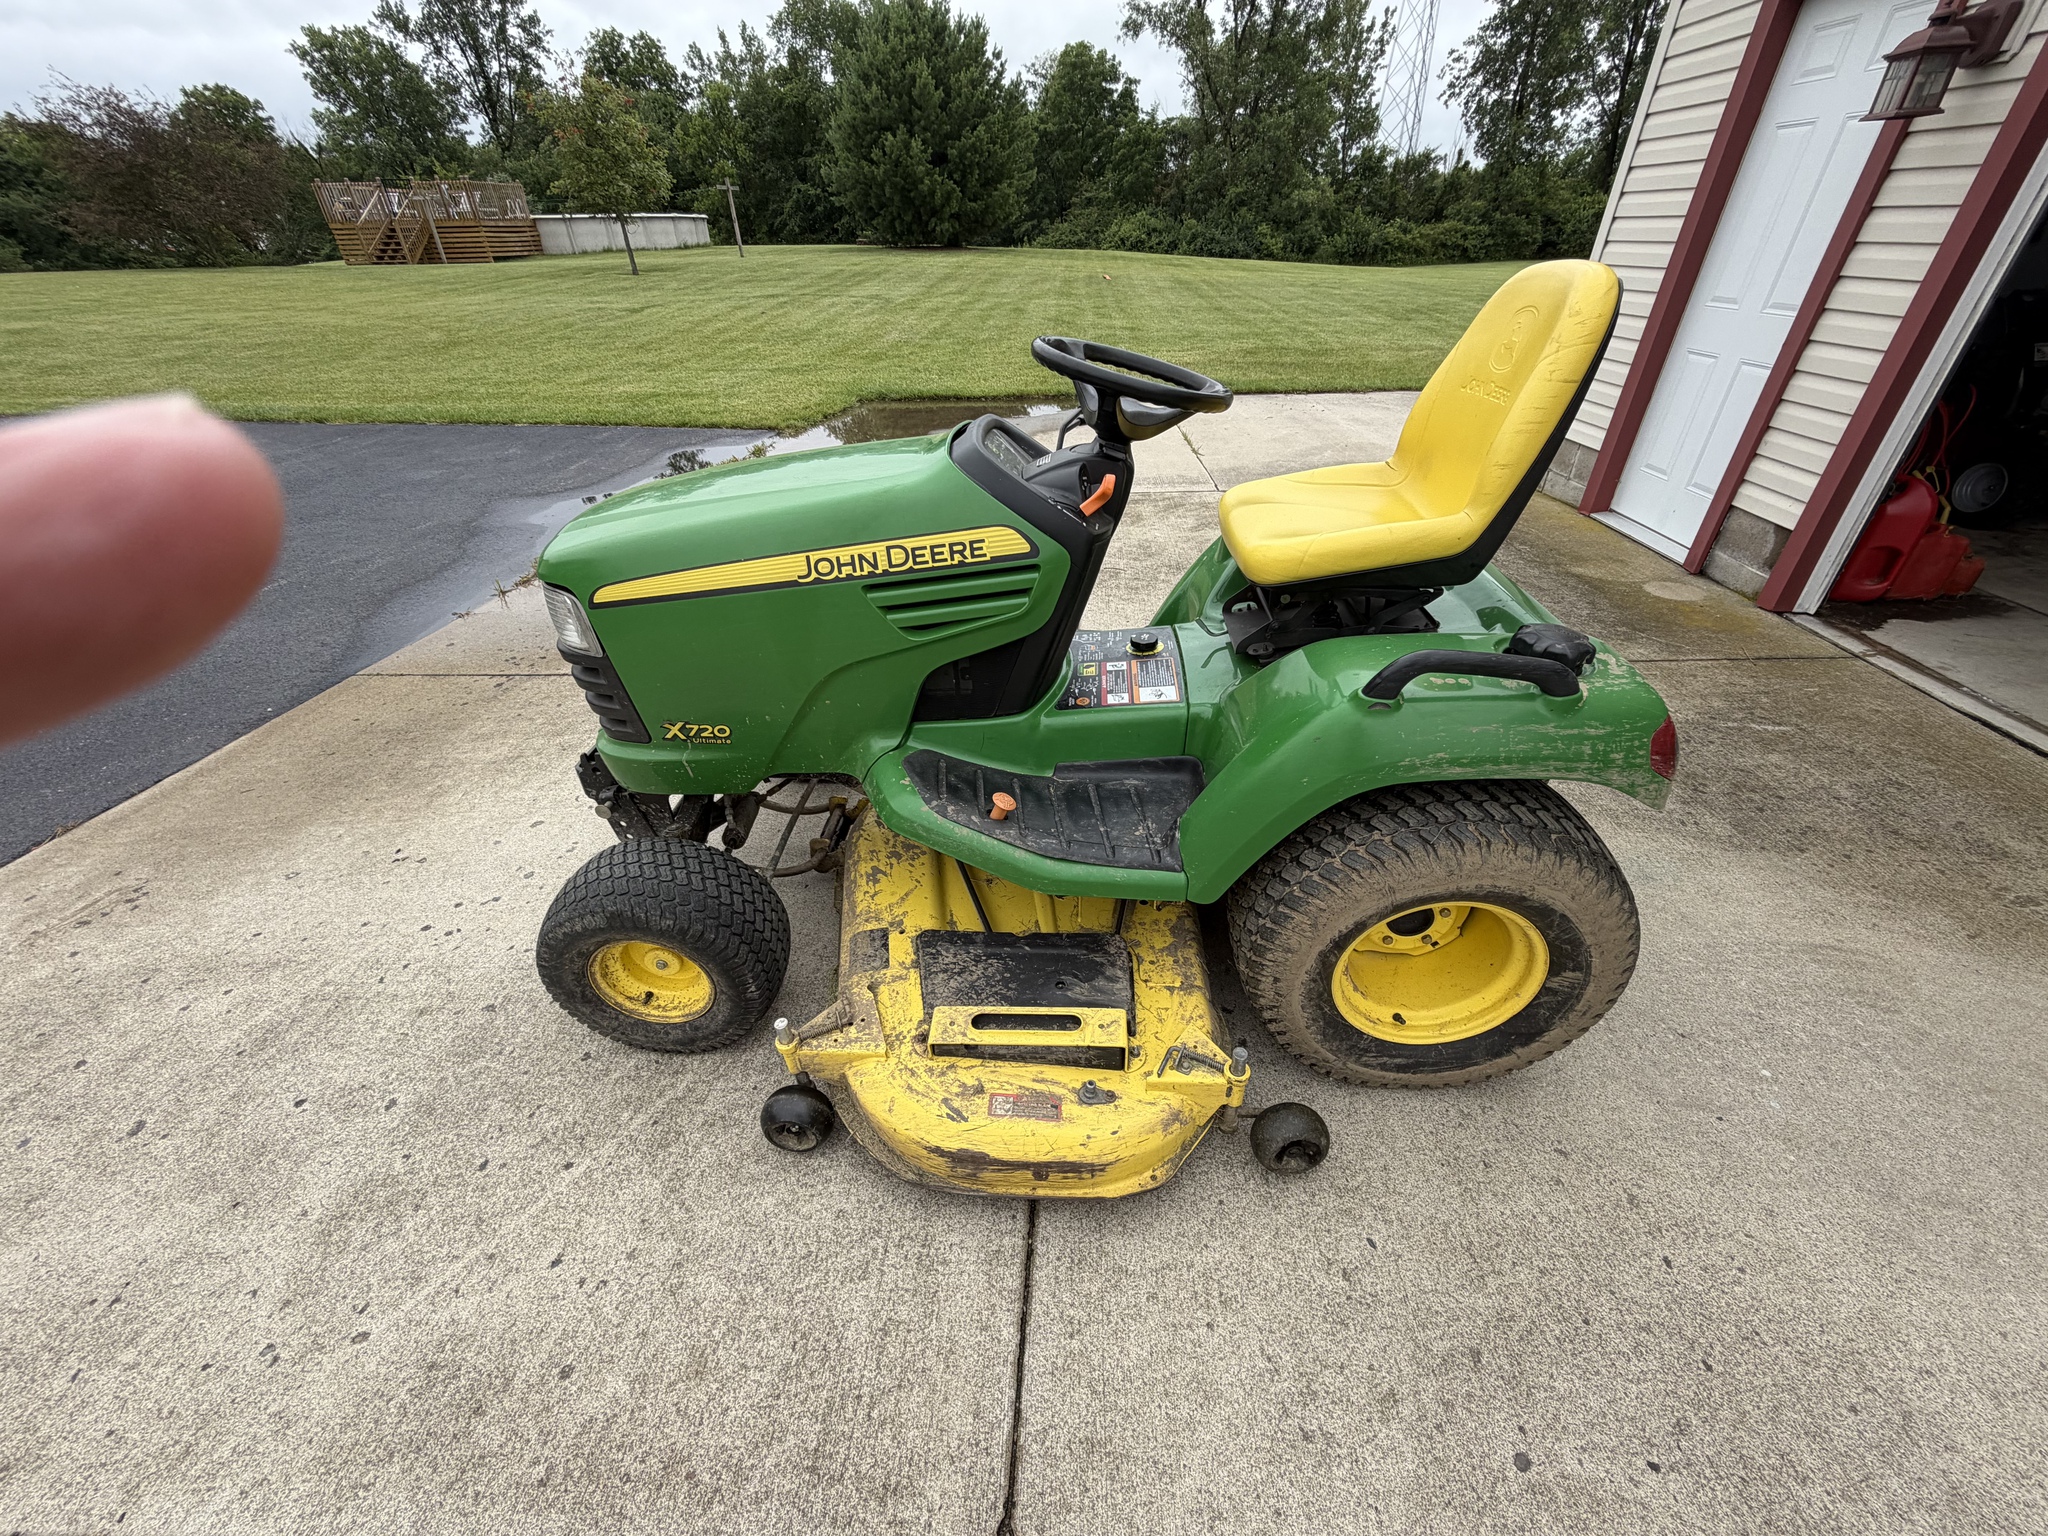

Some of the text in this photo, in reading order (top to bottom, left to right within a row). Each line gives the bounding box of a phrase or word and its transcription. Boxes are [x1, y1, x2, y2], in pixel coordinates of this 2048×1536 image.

[797, 538, 988, 580] JOHN DEERE
[661, 720, 732, 741] X720
[692, 737, 732, 745] Ultimate
